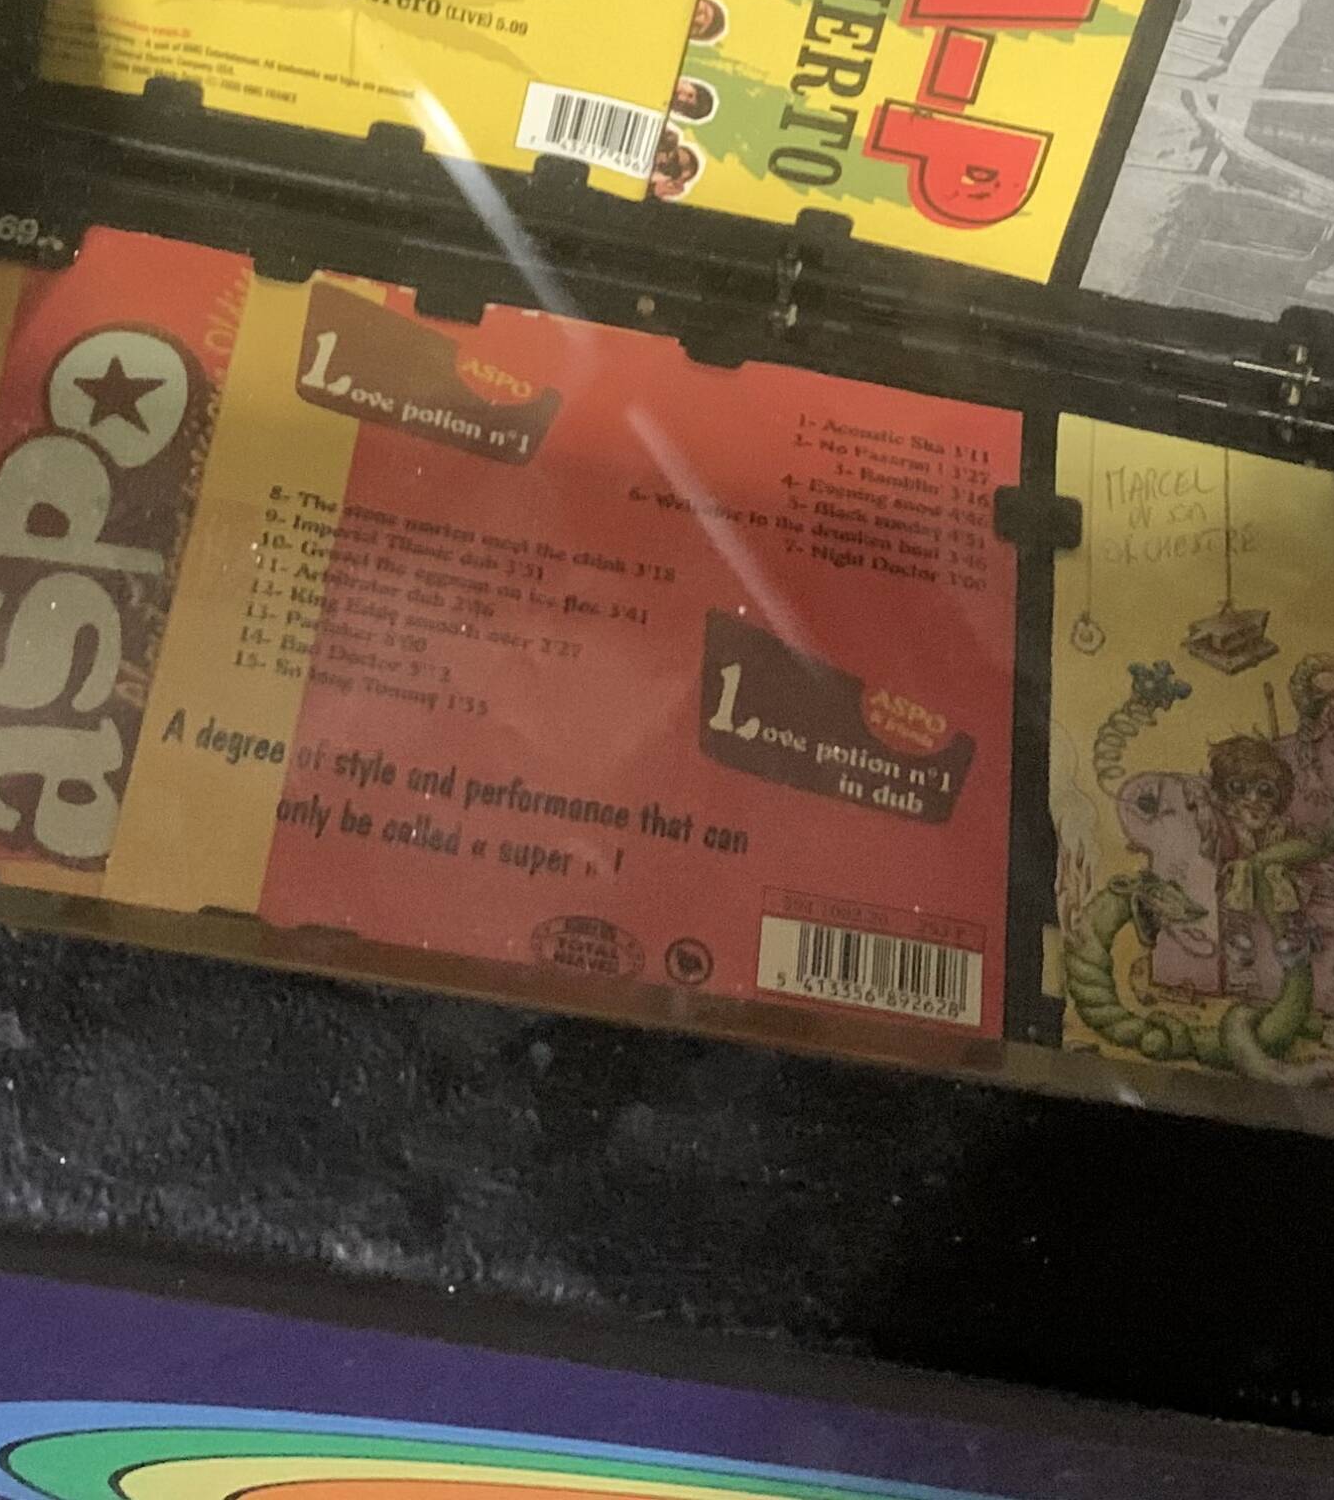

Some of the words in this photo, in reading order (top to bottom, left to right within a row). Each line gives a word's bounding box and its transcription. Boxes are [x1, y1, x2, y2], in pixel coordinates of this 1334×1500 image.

[445, 3, 493, 31] (LIVE)
[301, 331, 394, 412] Love
[401, 400, 482, 440] potion
[459, 357, 533, 398] ASPO
[822, 419, 905, 446] Acoustic
[910, 436, 945, 455] Ska
[299, 490, 337, 513] The
[811, 544, 865, 569] Night
[709, 663, 807, 752] Love
[816, 741, 901, 779] potion
[868, 689, 948, 734] ASPO
[162, 708, 186, 743] A
[197, 716, 286, 765] degree
[335, 750, 398, 788] style
[406, 765, 456, 798] and
[463, 775, 631, 830] performance
[639, 801, 694, 843] that
[702, 824, 749, 854] can
[839, 772, 864, 799] in
[872, 785, 924, 814] dub
[340, 802, 373, 837] be
[381, 813, 462, 856] called
[498, 838, 574, 877] super
